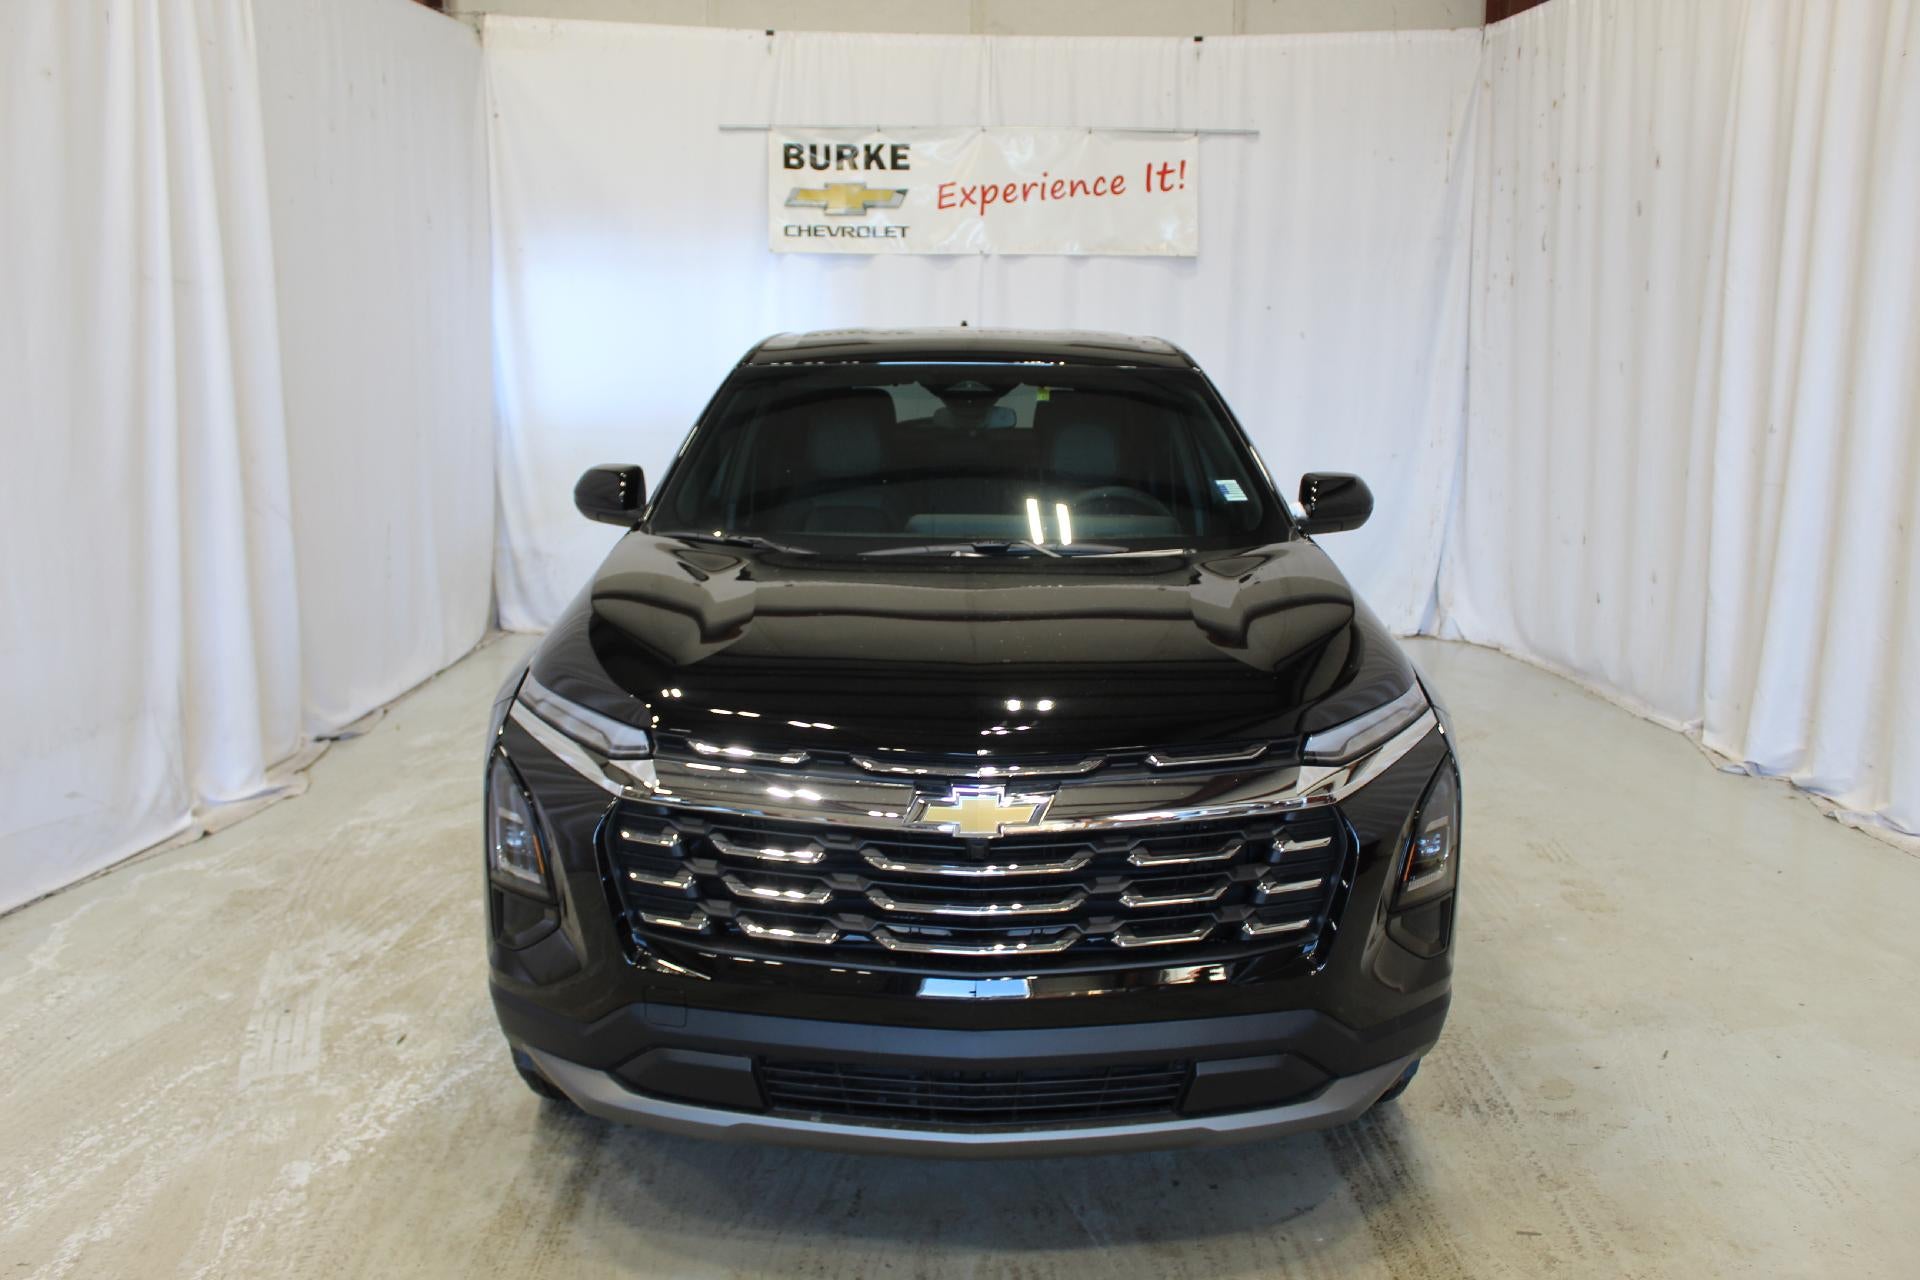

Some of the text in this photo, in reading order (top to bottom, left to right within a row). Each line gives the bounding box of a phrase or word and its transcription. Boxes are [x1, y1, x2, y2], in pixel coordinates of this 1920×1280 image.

[783, 143, 910, 170] BURKE
[937, 160, 1187, 216] Experience It!
[784, 225, 909, 238] CHEVROLET
